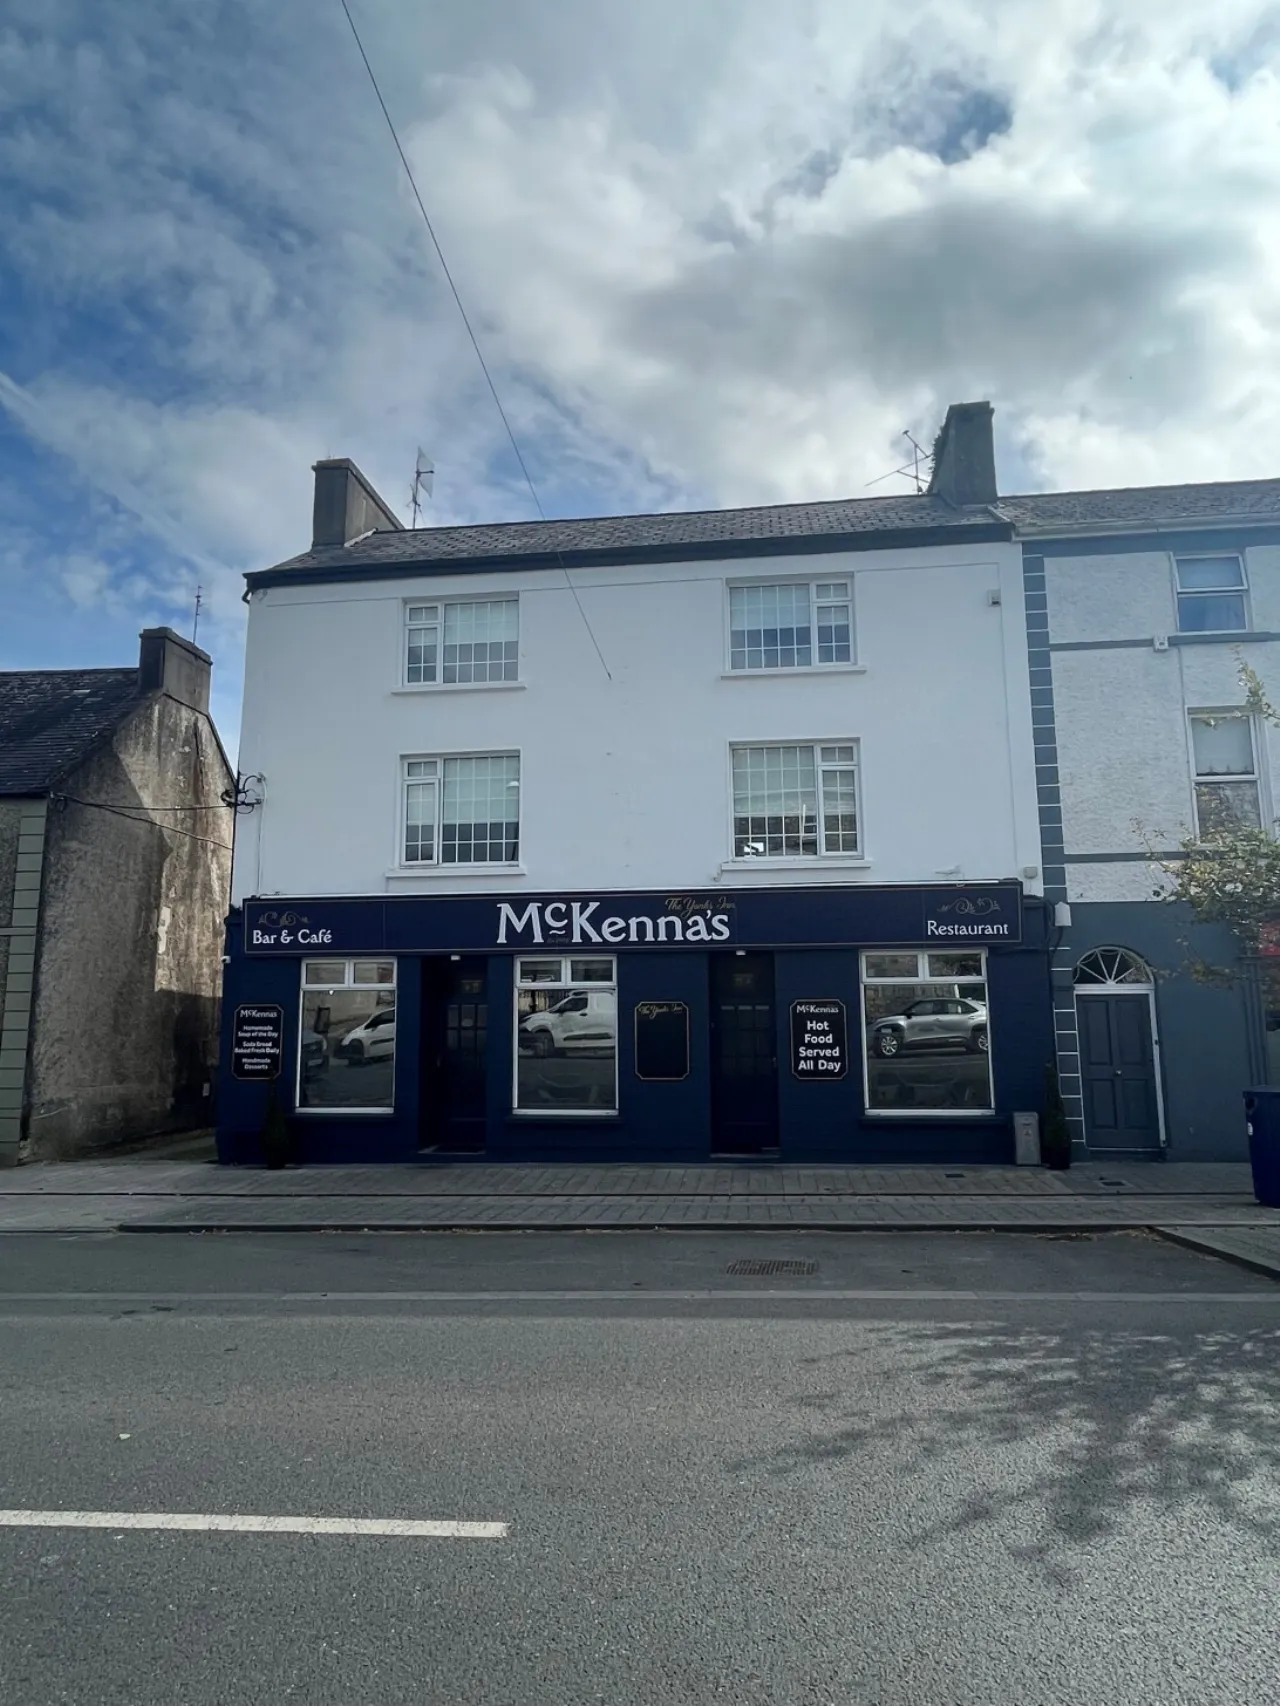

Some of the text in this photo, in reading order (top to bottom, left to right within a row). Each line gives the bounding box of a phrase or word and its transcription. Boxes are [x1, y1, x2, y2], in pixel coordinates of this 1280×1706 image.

[664, 897, 683, 911] The
[716, 896, 736, 910] Inn
[496, 901, 730, 943] McKenna's
[927, 920, 1009, 936] Restaurant
[252, 928, 333, 944] Bar & Café
[807, 1020, 830, 1031] Hot
[267, 1031, 279, 1039] Day
[804, 1033, 833, 1044] Food
[798, 1046, 840, 1057] Served
[798, 1059, 842, 1073] All Day
